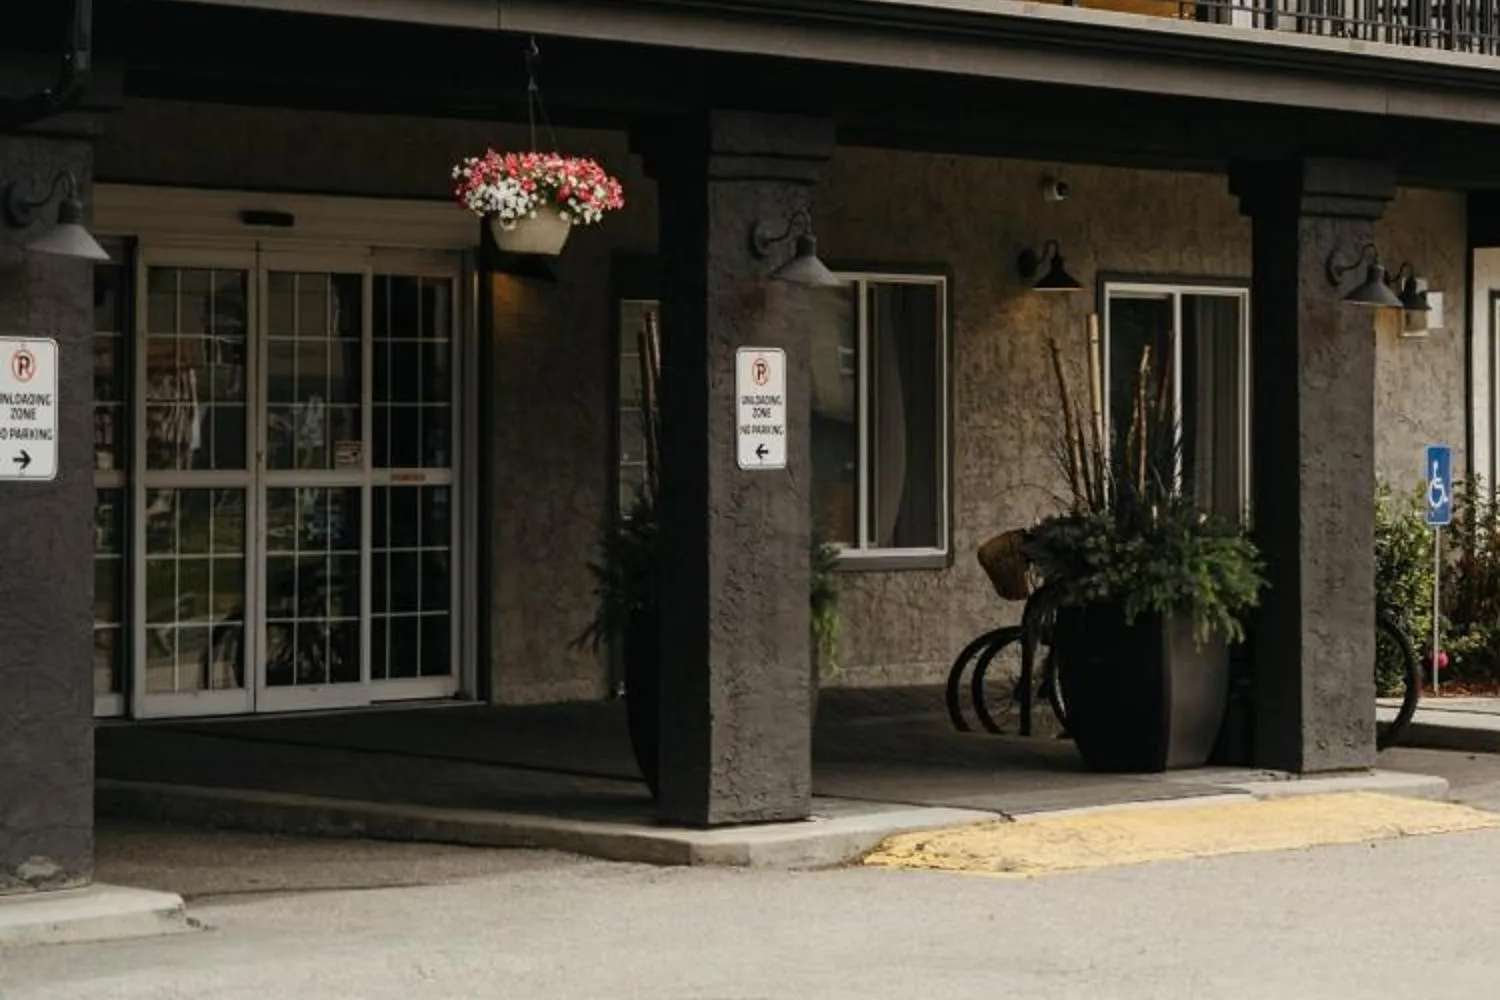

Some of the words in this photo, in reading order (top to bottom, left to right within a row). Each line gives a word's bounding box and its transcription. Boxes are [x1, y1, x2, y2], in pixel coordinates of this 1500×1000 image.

[0, 393, 52, 406] NLOADING
[10, 407, 37, 420] ZONE
[752, 407, 772, 419] ZONE
[10, 427, 53, 441] PARKING
